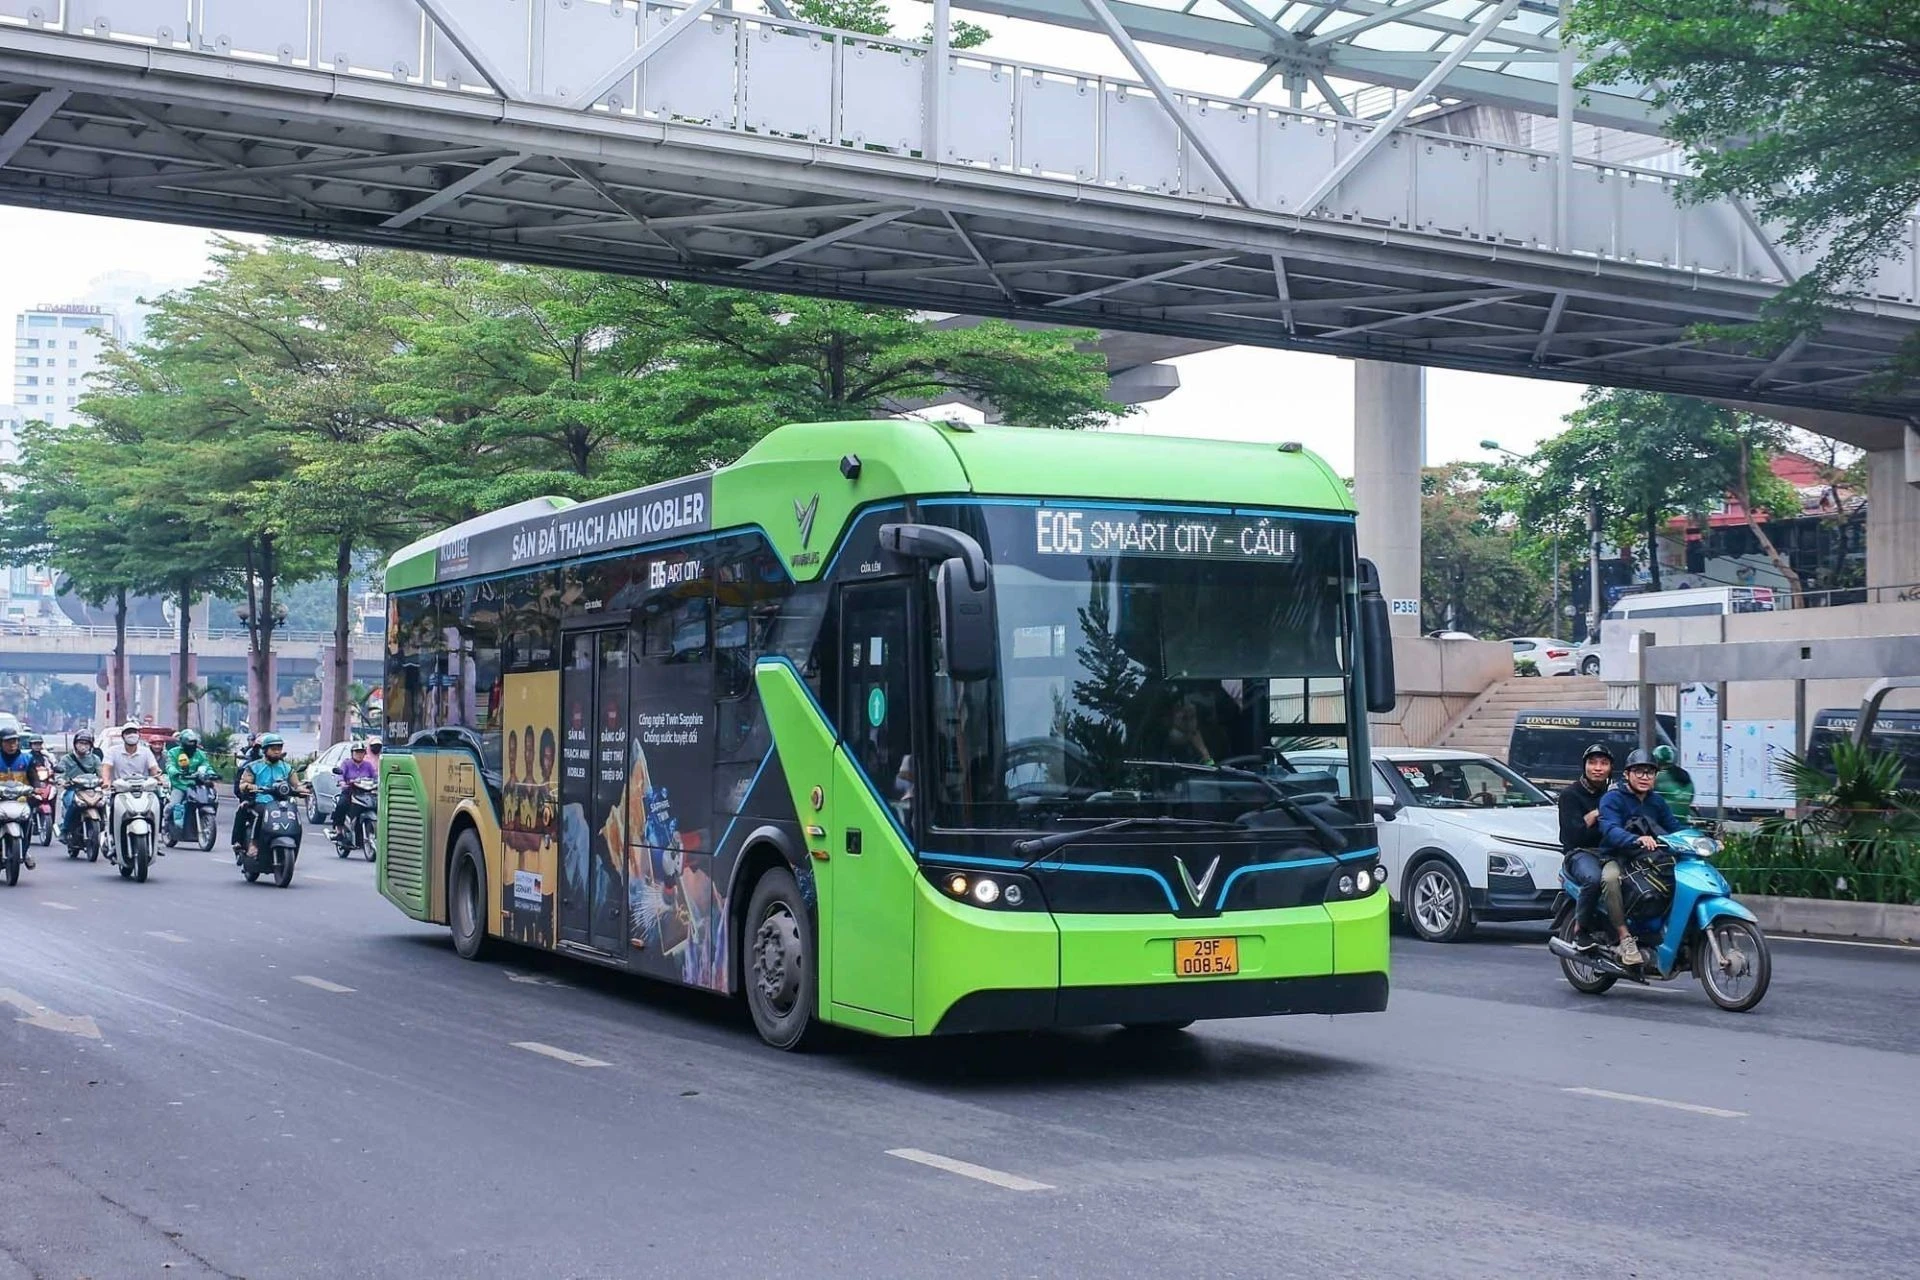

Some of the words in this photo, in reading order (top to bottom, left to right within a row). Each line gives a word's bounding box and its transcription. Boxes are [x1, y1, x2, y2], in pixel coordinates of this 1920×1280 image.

[512, 526, 536, 561] SÀN
[538, 519, 556, 555] ĐÁ
[559, 516, 604, 556] THẠCH
[607, 507, 638, 541] ANH
[642, 493, 704, 534] KOBLER
[1037, 510, 1082, 554] E05
[1090, 521, 1167, 552] SMART
[1174, 524, 1216, 553] CITY
[1240, 517, 1283, 556] CẦU
[667, 563, 683, 583] ART
[684, 561, 700, 580] CITY
[665, 713, 679, 725] Twin
[679, 712, 704, 727] Sapphire
[1526, 717, 1550, 725] LONG
[567, 767, 586, 778] KOBLER
[1194, 940, 1220, 956] 29F
[1183, 957, 1232, 973] 008.54
